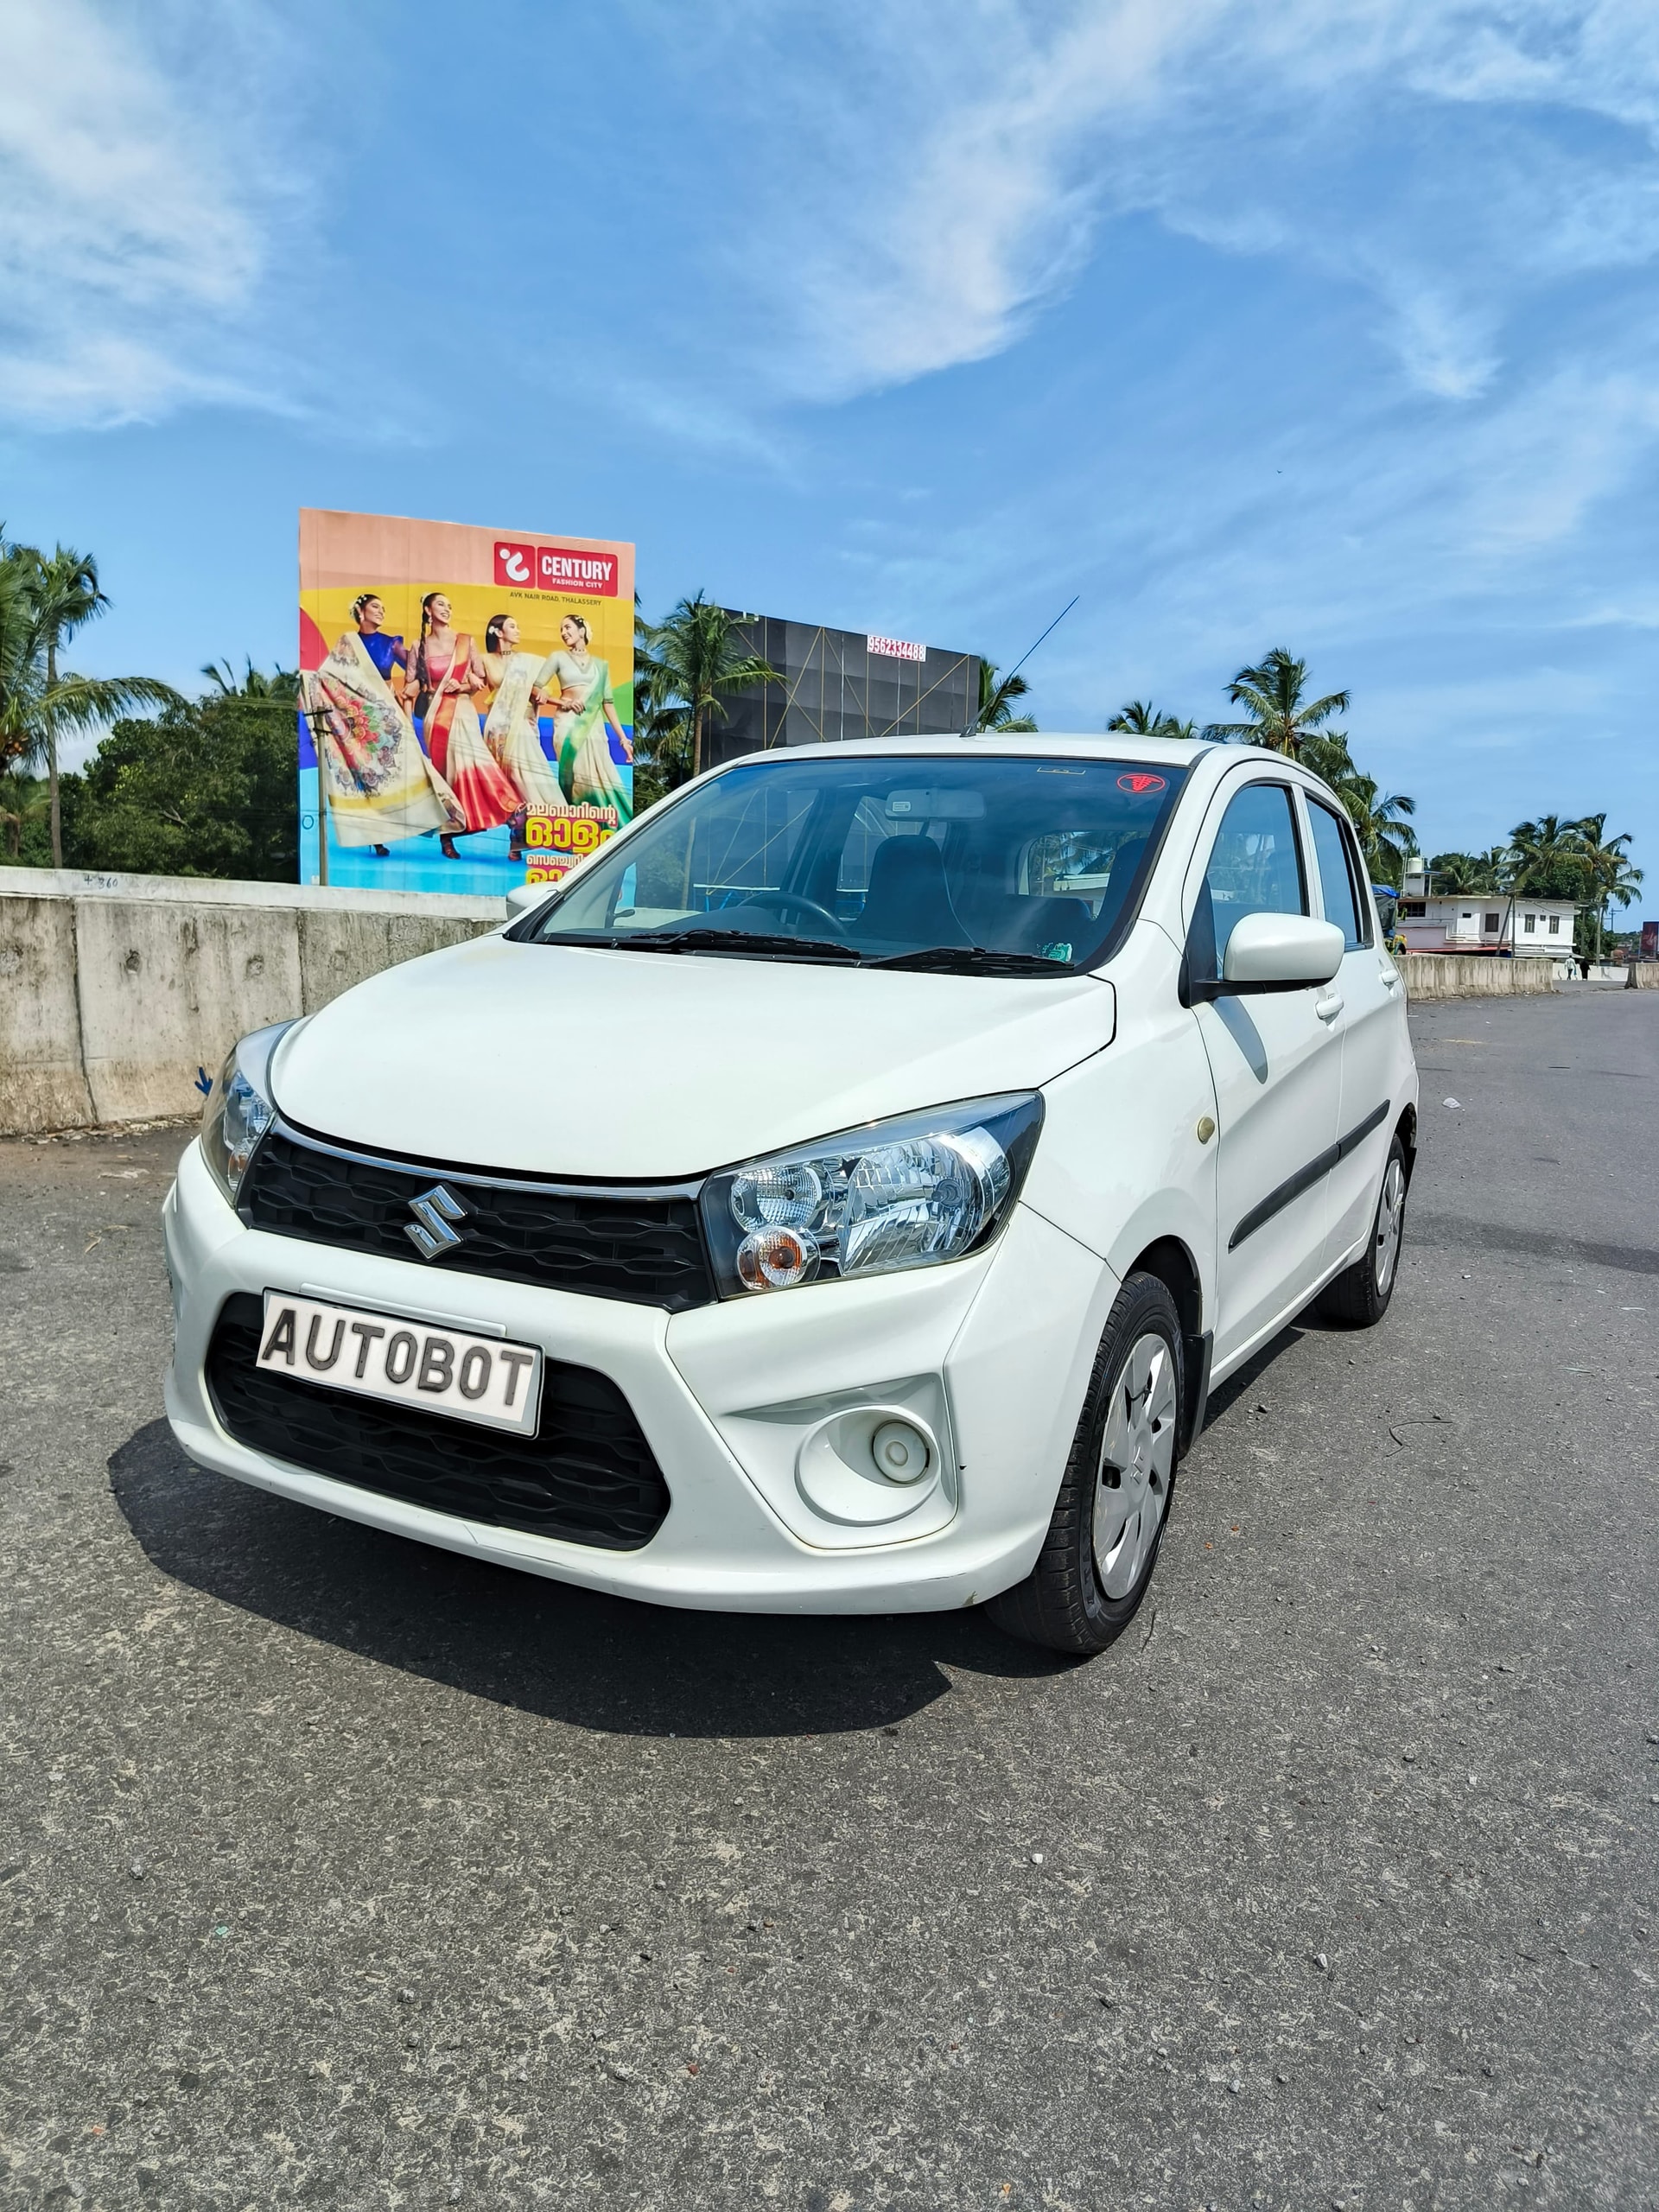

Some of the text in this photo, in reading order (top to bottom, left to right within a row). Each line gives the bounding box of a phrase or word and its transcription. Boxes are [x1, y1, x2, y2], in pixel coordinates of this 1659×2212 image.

[542, 556, 613, 582] CENTURY
[551, 577, 584, 588] FASHION
[510, 591, 523, 600] AVK
[562, 596, 602, 606] THALASSERY
[868, 636, 924, 660] 9562334488
[261, 1308, 534, 1407] AUTOBOT
